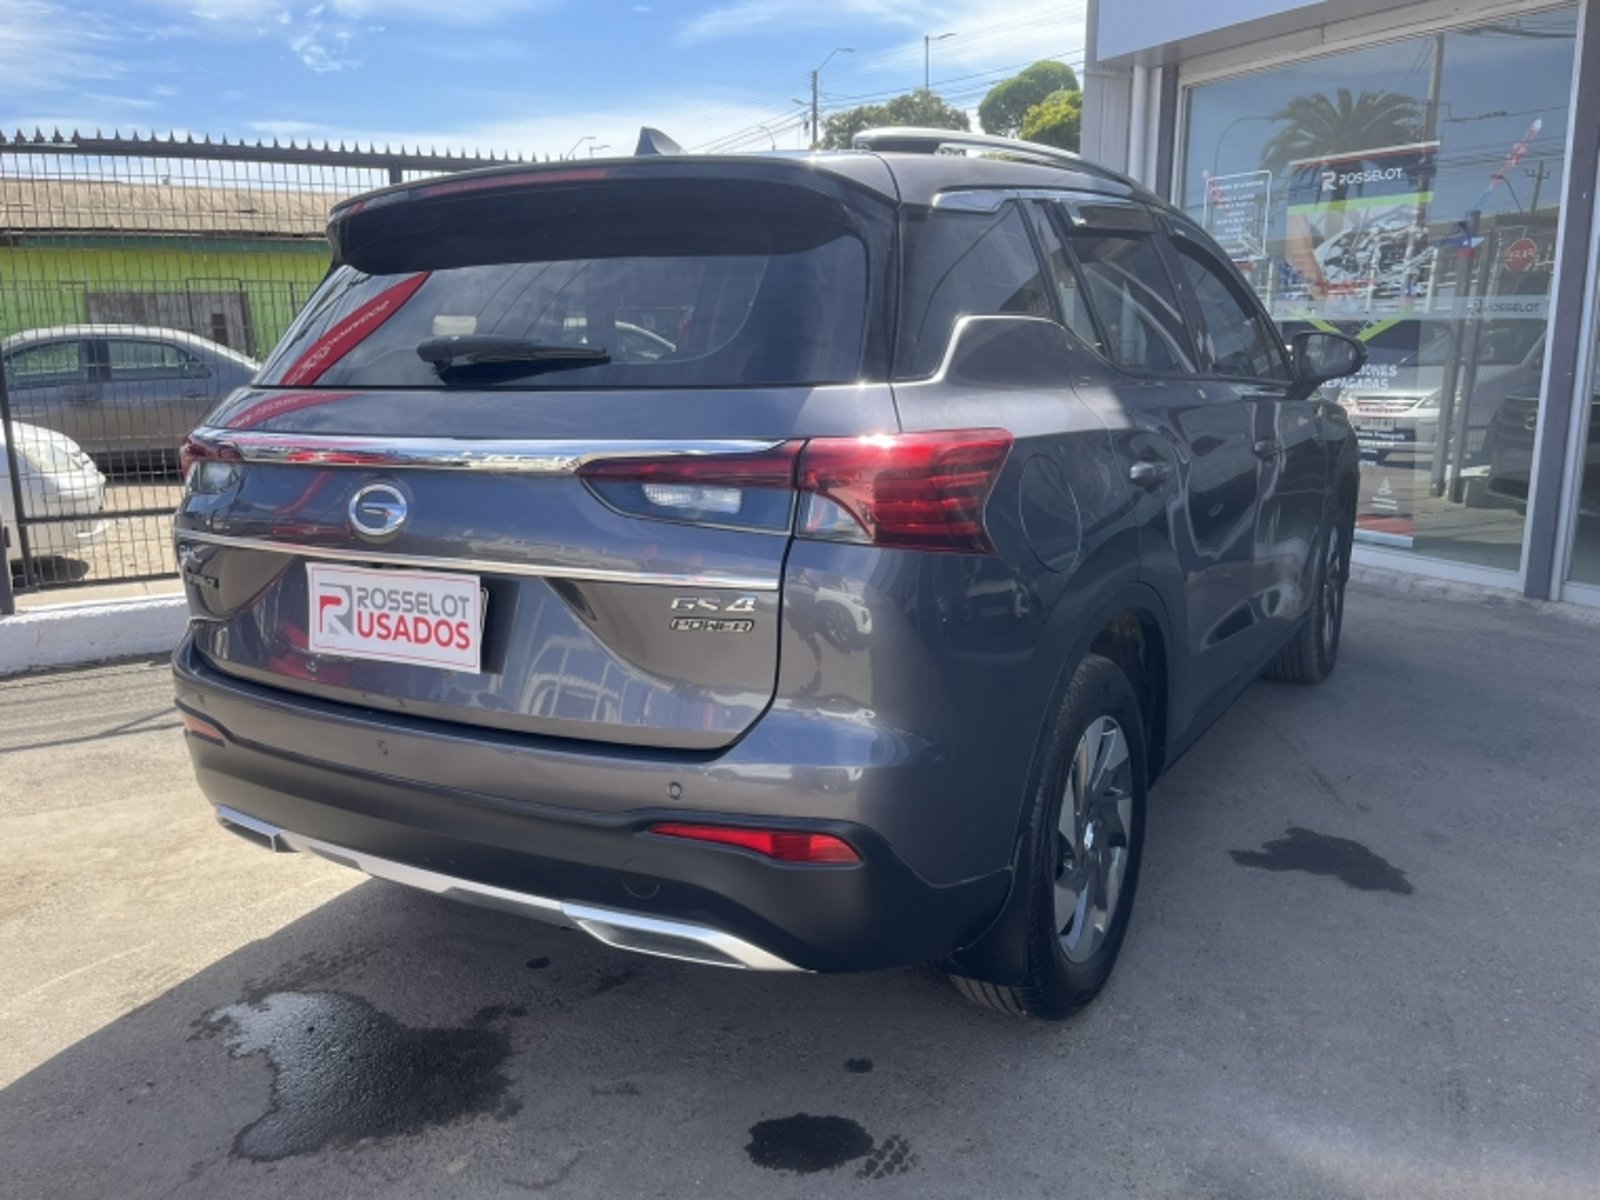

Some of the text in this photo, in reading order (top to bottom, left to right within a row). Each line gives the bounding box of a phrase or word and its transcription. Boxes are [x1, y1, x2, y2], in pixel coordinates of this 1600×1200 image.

[1339, 168, 1403, 185] ROSSELOT
[356, 587, 470, 619] ROSSELOT
[357, 611, 470, 650] USADOS
